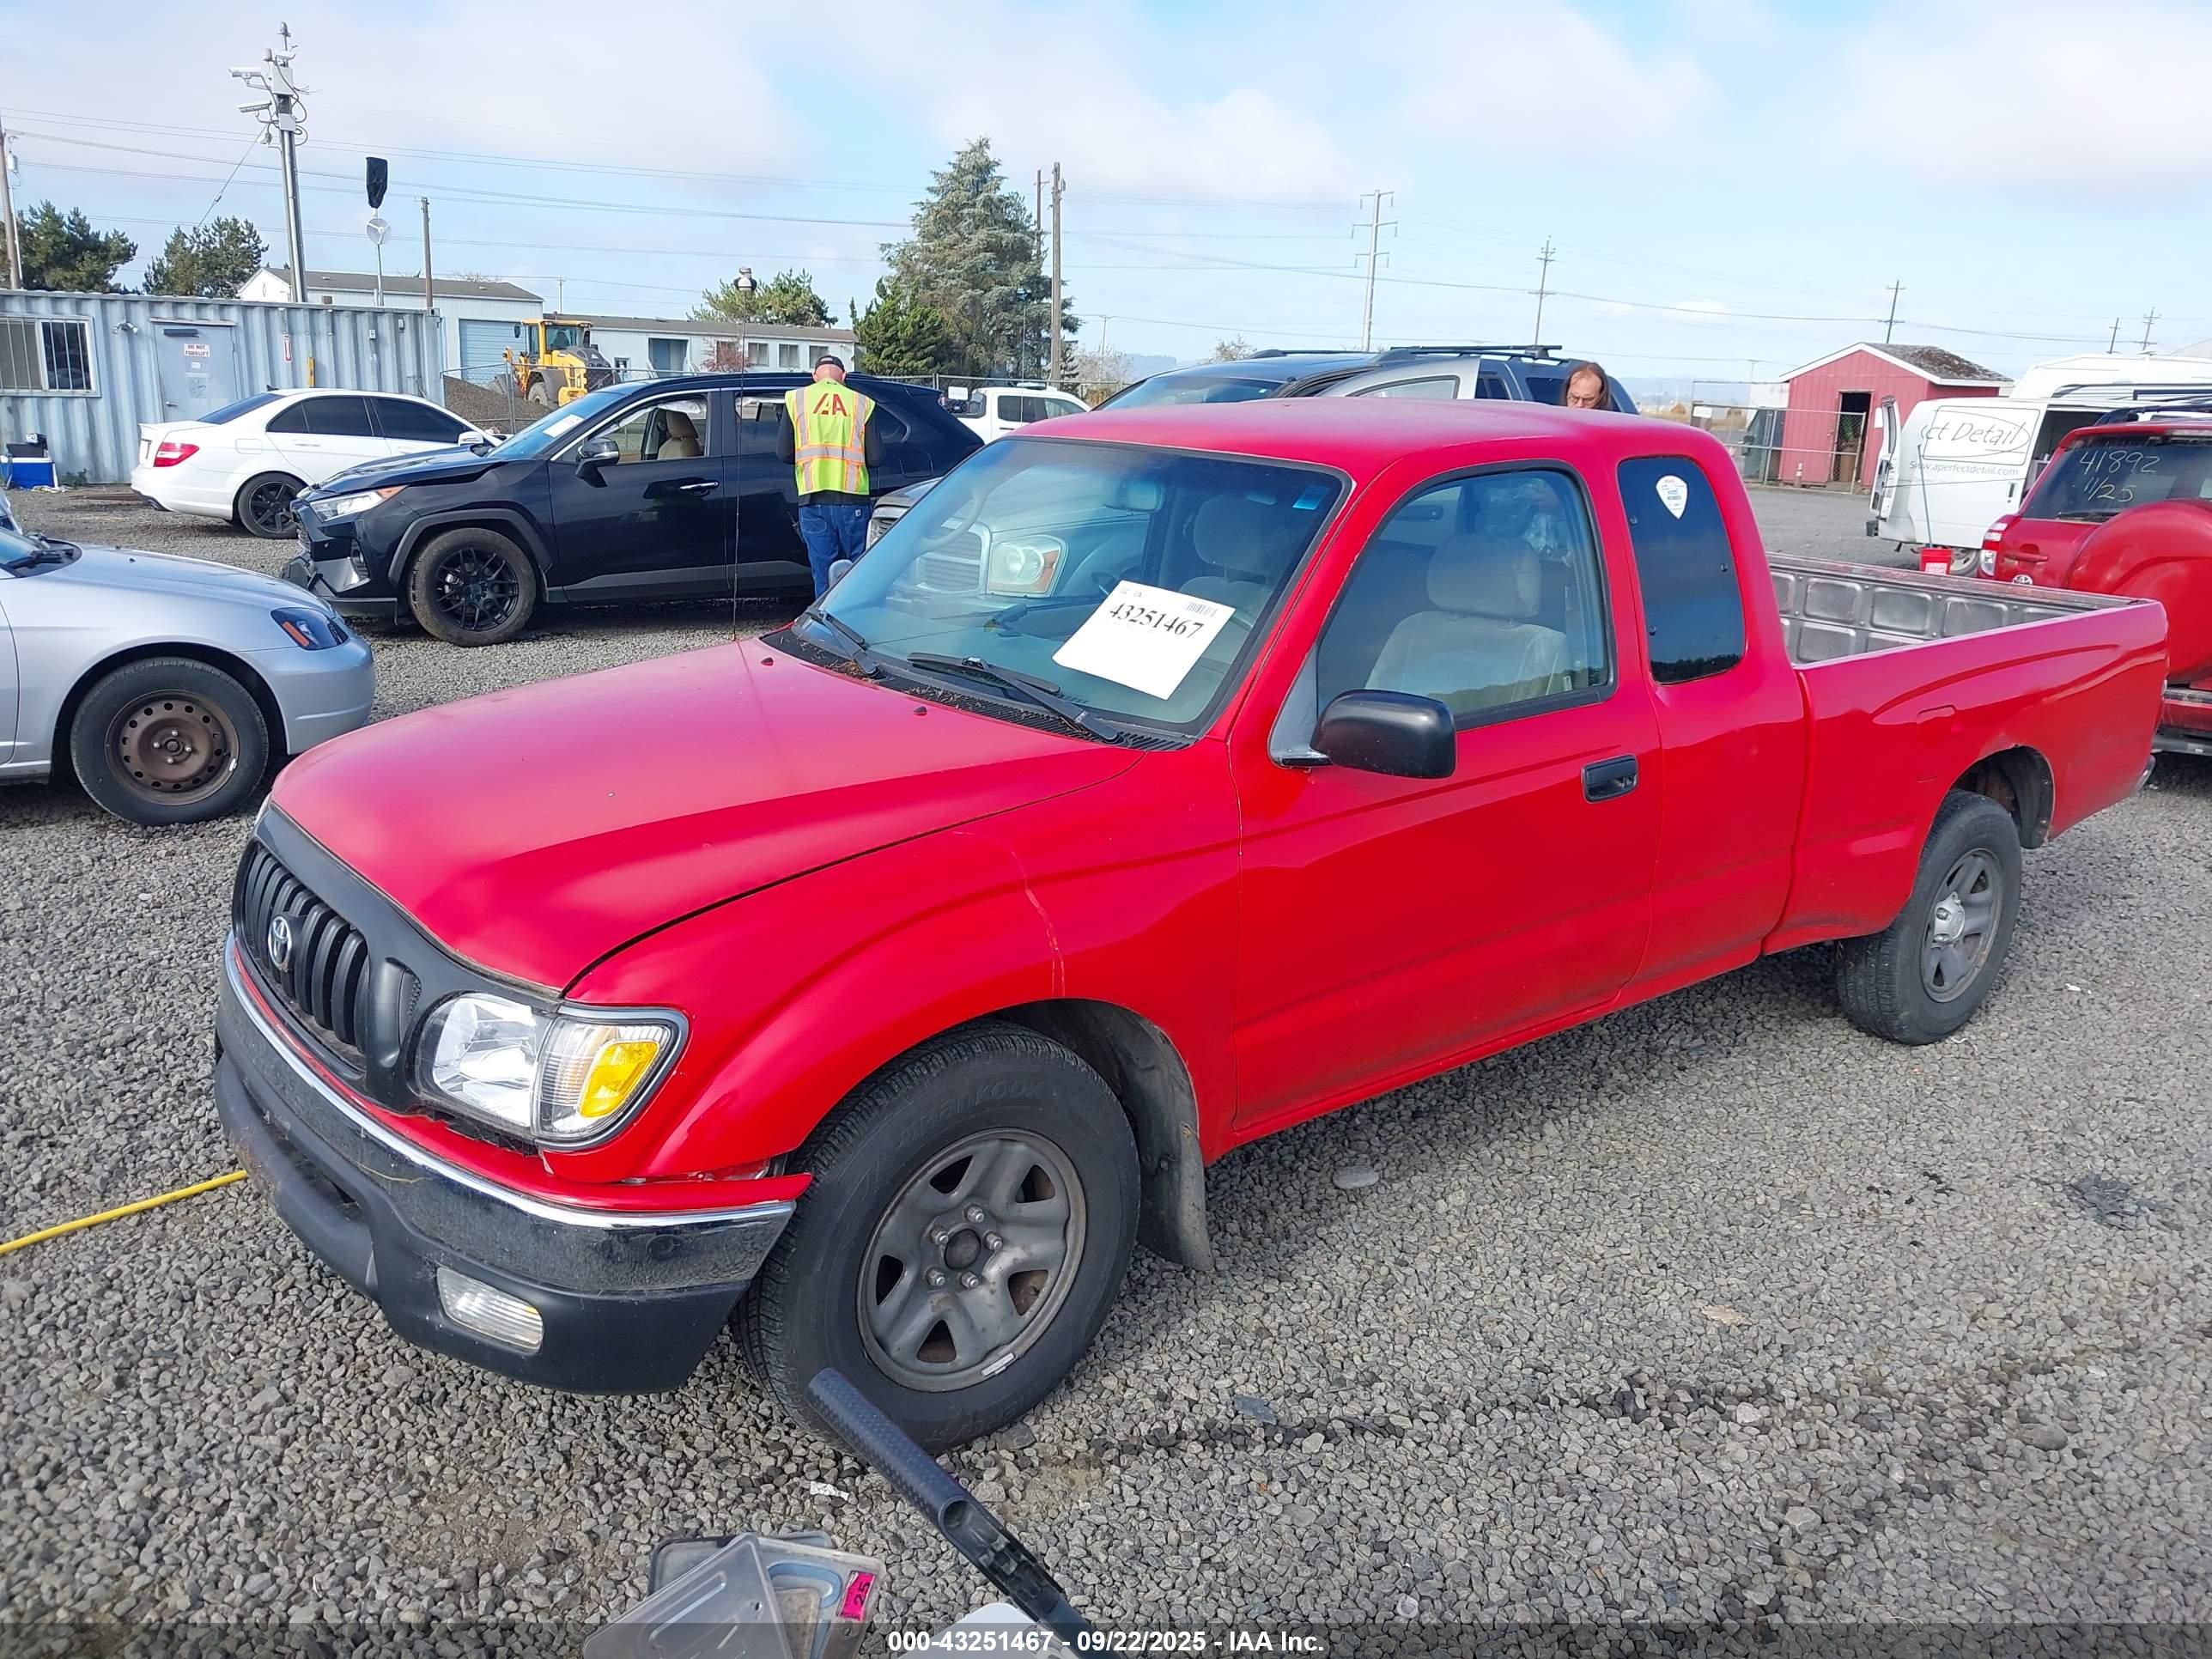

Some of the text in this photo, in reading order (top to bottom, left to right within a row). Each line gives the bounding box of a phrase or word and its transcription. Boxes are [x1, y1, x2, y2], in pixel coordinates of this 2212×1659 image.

[1951, 422, 2027, 446] Detail
[2080, 450, 2161, 476] 41892
[2083, 477, 2137, 502] 11/25
[1109, 603, 1205, 639] 43251467
